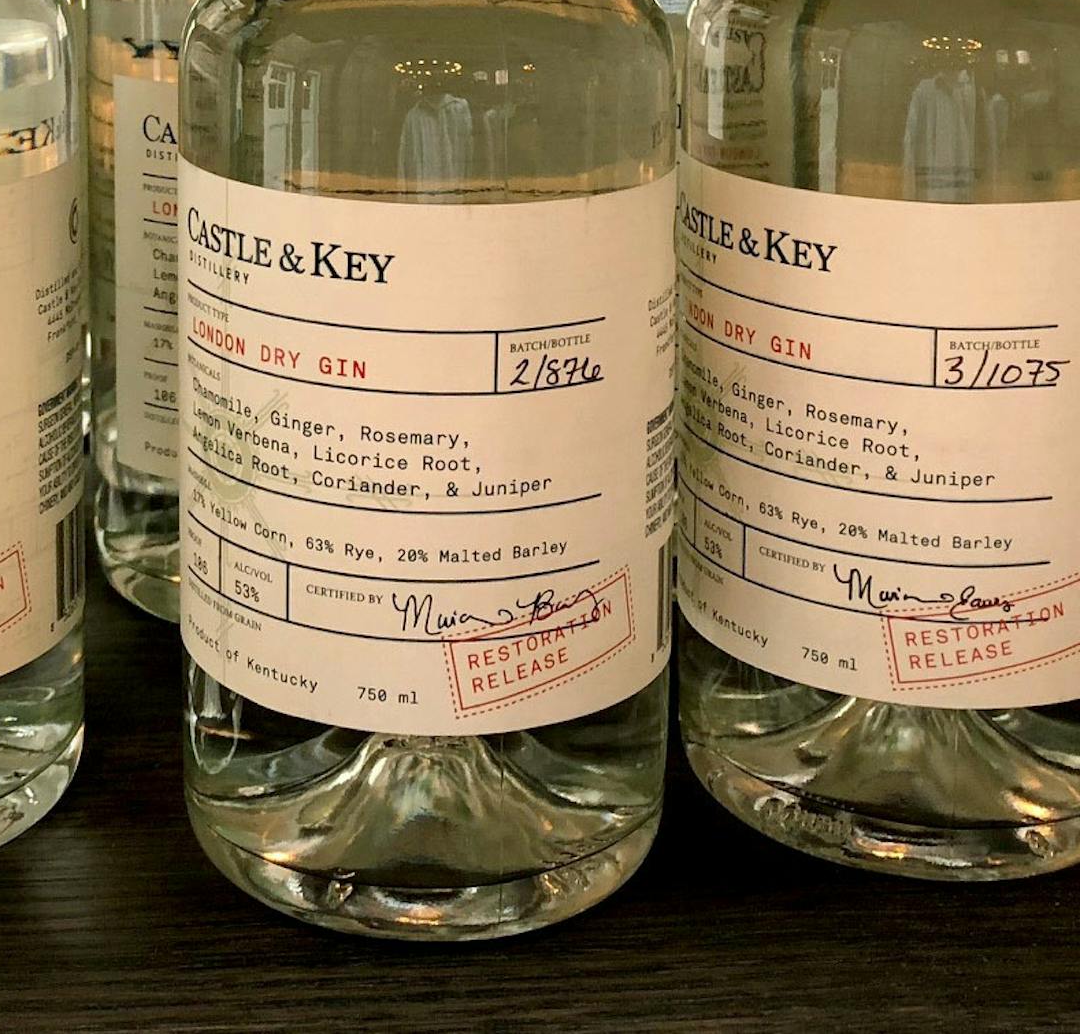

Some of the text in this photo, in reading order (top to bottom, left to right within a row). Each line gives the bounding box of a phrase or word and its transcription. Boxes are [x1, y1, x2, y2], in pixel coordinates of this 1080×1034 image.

[187, 206, 395, 284] CASTLE & KEY
[739, 227, 760, 258] &
[764, 227, 838, 272] KEY
[189, 248, 250, 285] DISTILLERY
[212, 306, 230, 323] TYPE
[192, 316, 246, 356] LONDON
[260, 344, 301, 370] DRY
[319, 356, 367, 379] GIN
[509, 333, 591, 353] BATCH/BOTTLE
[724, 320, 756, 345] DRY
[771, 335, 812, 360] GIN
[949, 339, 1041, 351] BATCH/BOTTLE
[944, 349, 1071, 388] 3/1075
[192, 376, 259, 424] Chamomile,
[270, 409, 345, 442] Ginger,
[360, 425, 470, 449] Rosemary,
[701, 389, 920, 462] Verbena, Licorice Root,
[732, 381, 792, 416] Ginger,
[805, 403, 908, 436] Rosemary,
[192, 400, 221, 431] Lemon
[226, 419, 299, 460] Verbena,
[313, 445, 409, 470] Licorice
[422, 454, 481, 474] Root,
[718, 422, 754, 452] Root,
[764, 440, 870, 480] Coriander,
[885, 465, 898, 481] &
[911, 468, 996, 490] Juniper
[192, 426, 552, 501] Angelica Root, Coriander, & Juniper
[210, 502, 247, 531] Yellow
[254, 522, 294, 548] Corn,
[306, 537, 335, 553] 63%
[344, 543, 383, 563] Rye,
[397, 548, 429, 563] 20%
[439, 548, 502, 563] Malted
[512, 540, 568, 560] Barley
[719, 484, 750, 510] Corn,
[759, 501, 784, 520] 63%
[792, 511, 826, 534] Rye,
[838, 522, 868, 539] 20%
[878, 528, 940, 548] Malted
[952, 535, 1013, 552] Barley
[704, 536, 723, 560] 53%
[759, 545, 826, 573] CERTIFIED BY
[233, 561, 273, 584] ALC/VOL
[234, 579, 260, 603] 53%
[306, 584, 383, 605] CERTIFIED BY
[234, 612, 263, 632] GRAIN
[467, 600, 612, 670] RESTORATION
[712, 607, 769, 648] Kentucky
[904, 602, 1065, 648] RESTORATION
[187, 613, 318, 694] Product of Kentucky
[471, 647, 569, 694] RELEASE
[801, 646, 858, 672] 750 ml
[908, 640, 1013, 670] RELEASE
[357, 686, 419, 705] 750 ml
